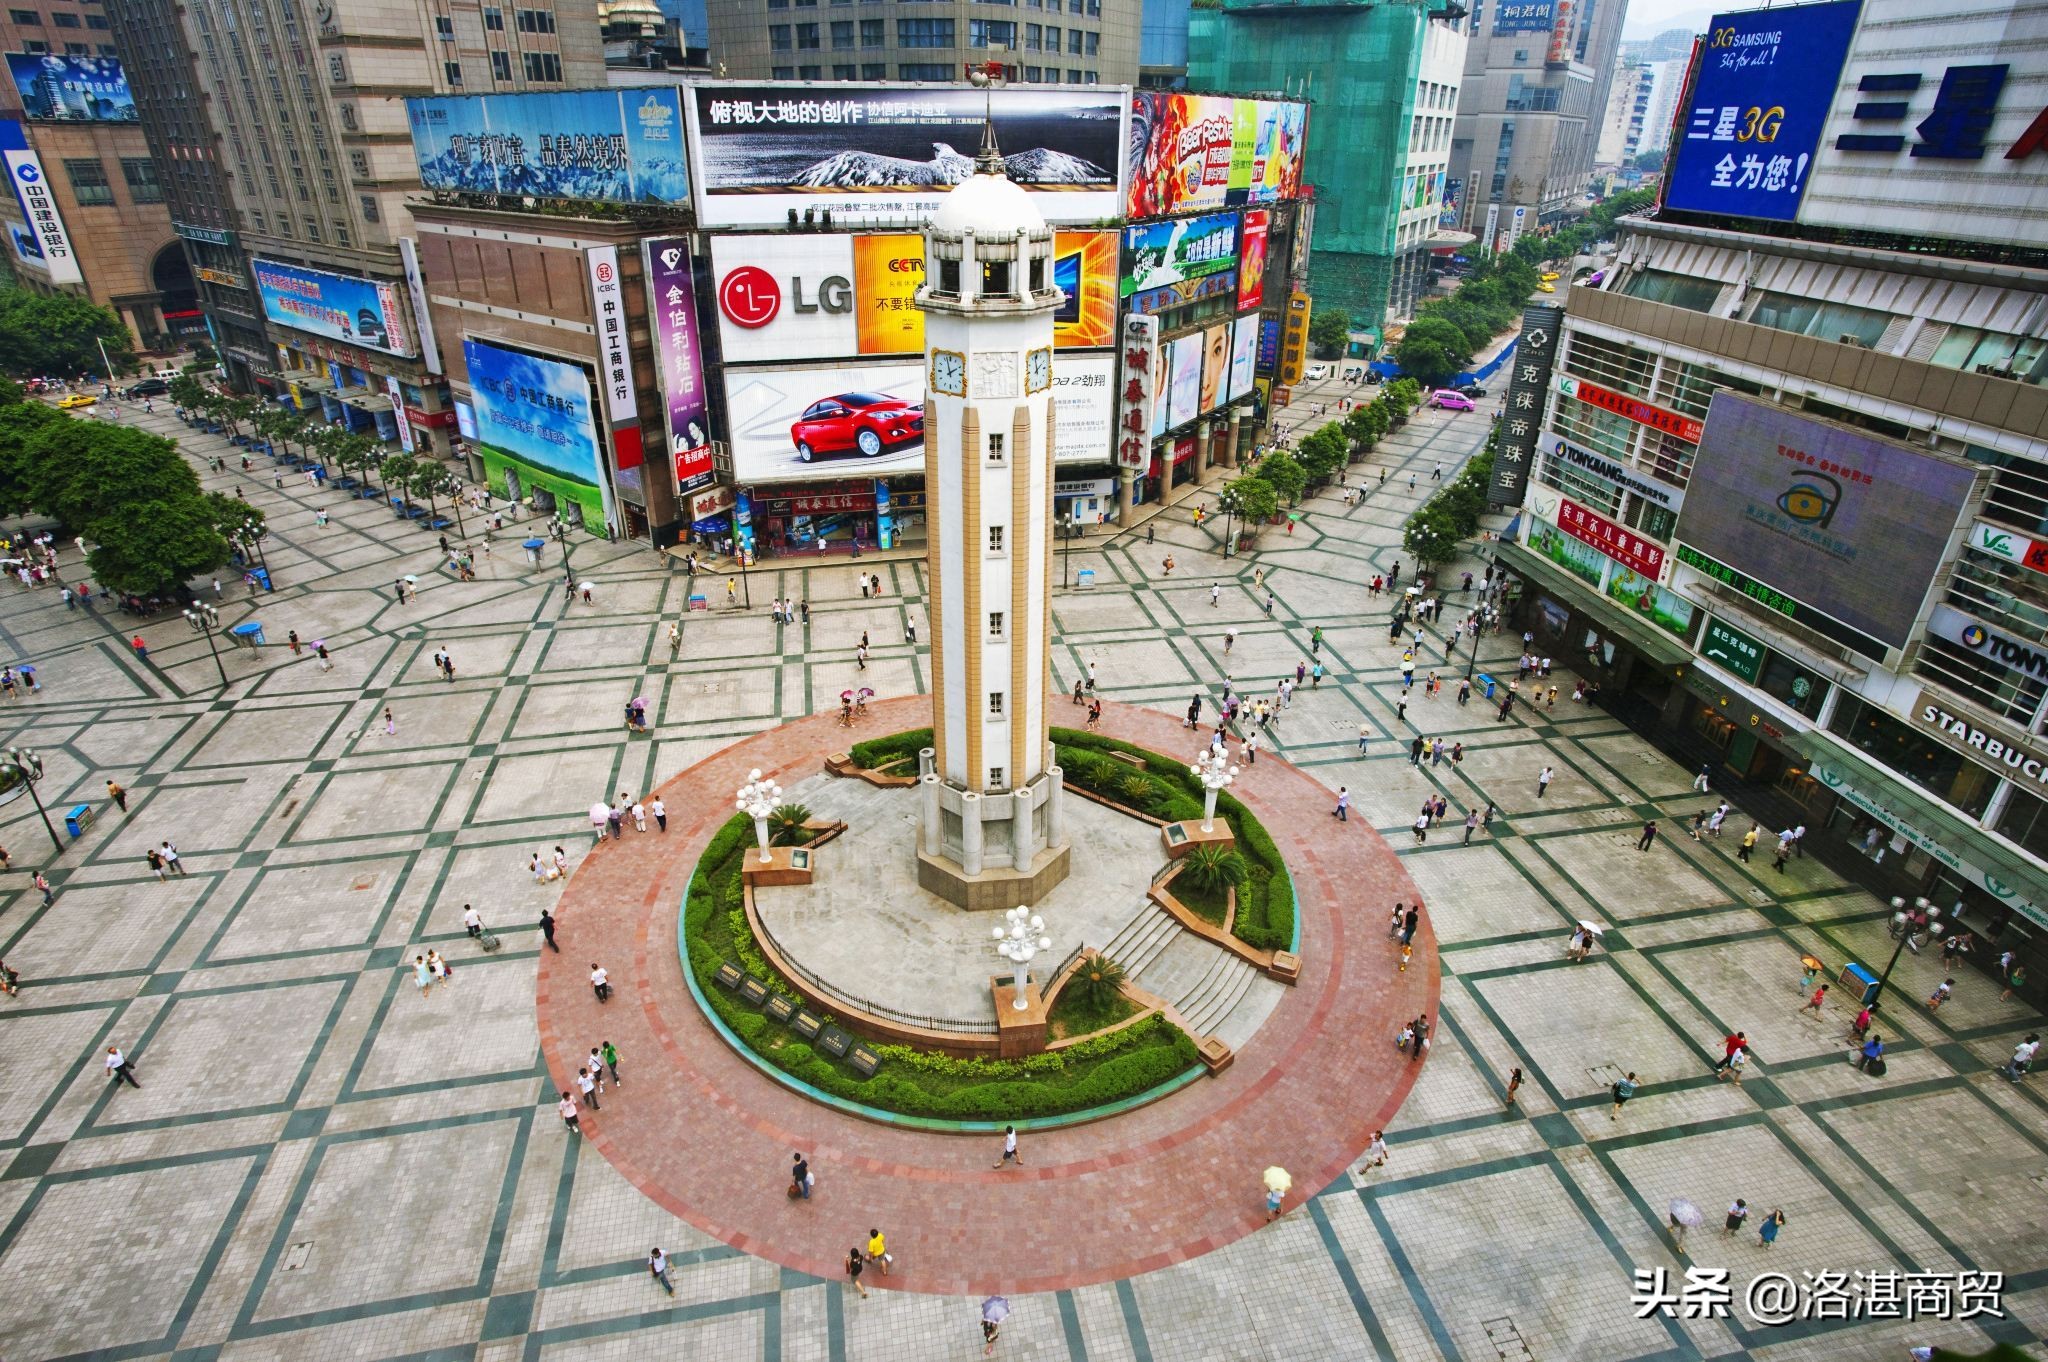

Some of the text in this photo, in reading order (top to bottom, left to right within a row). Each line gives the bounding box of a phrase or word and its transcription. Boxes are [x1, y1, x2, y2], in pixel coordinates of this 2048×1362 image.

[1503, 4, 1551, 18] 桐君阁
[1710, 27, 1782, 48] 3G SAMSUNG
[1719, 52, 1736, 69] 3G
[1735, 48, 1751, 72] for
[710, 100, 948, 124] 俯视大地的创作 协信阿卡迪亚
[1834, 64, 2011, 159] 三星
[539, 132, 629, 171] 品泰然境界
[26, 185, 67, 258] 中国建设银行
[597, 283, 616, 293] ICBC
[792, 275, 853, 315] LG
[603, 300, 628, 401] 中国工商银行
[665, 284, 694, 395] 金伯利钻石
[520, 385, 575, 417] 中国工商银行
[1119, 346, 1149, 466] 诚泰通信
[1498, 363, 1540, 489] 克徕帝珠宝
[677, 446, 711, 467] 广告招商中
[1711, 626, 1757, 659] 星巴克咖啡
[1845, 790, 1961, 870] AGRICULTURAL BANK OF CHINA
[2019, 904, 2048, 927] AGRIC
